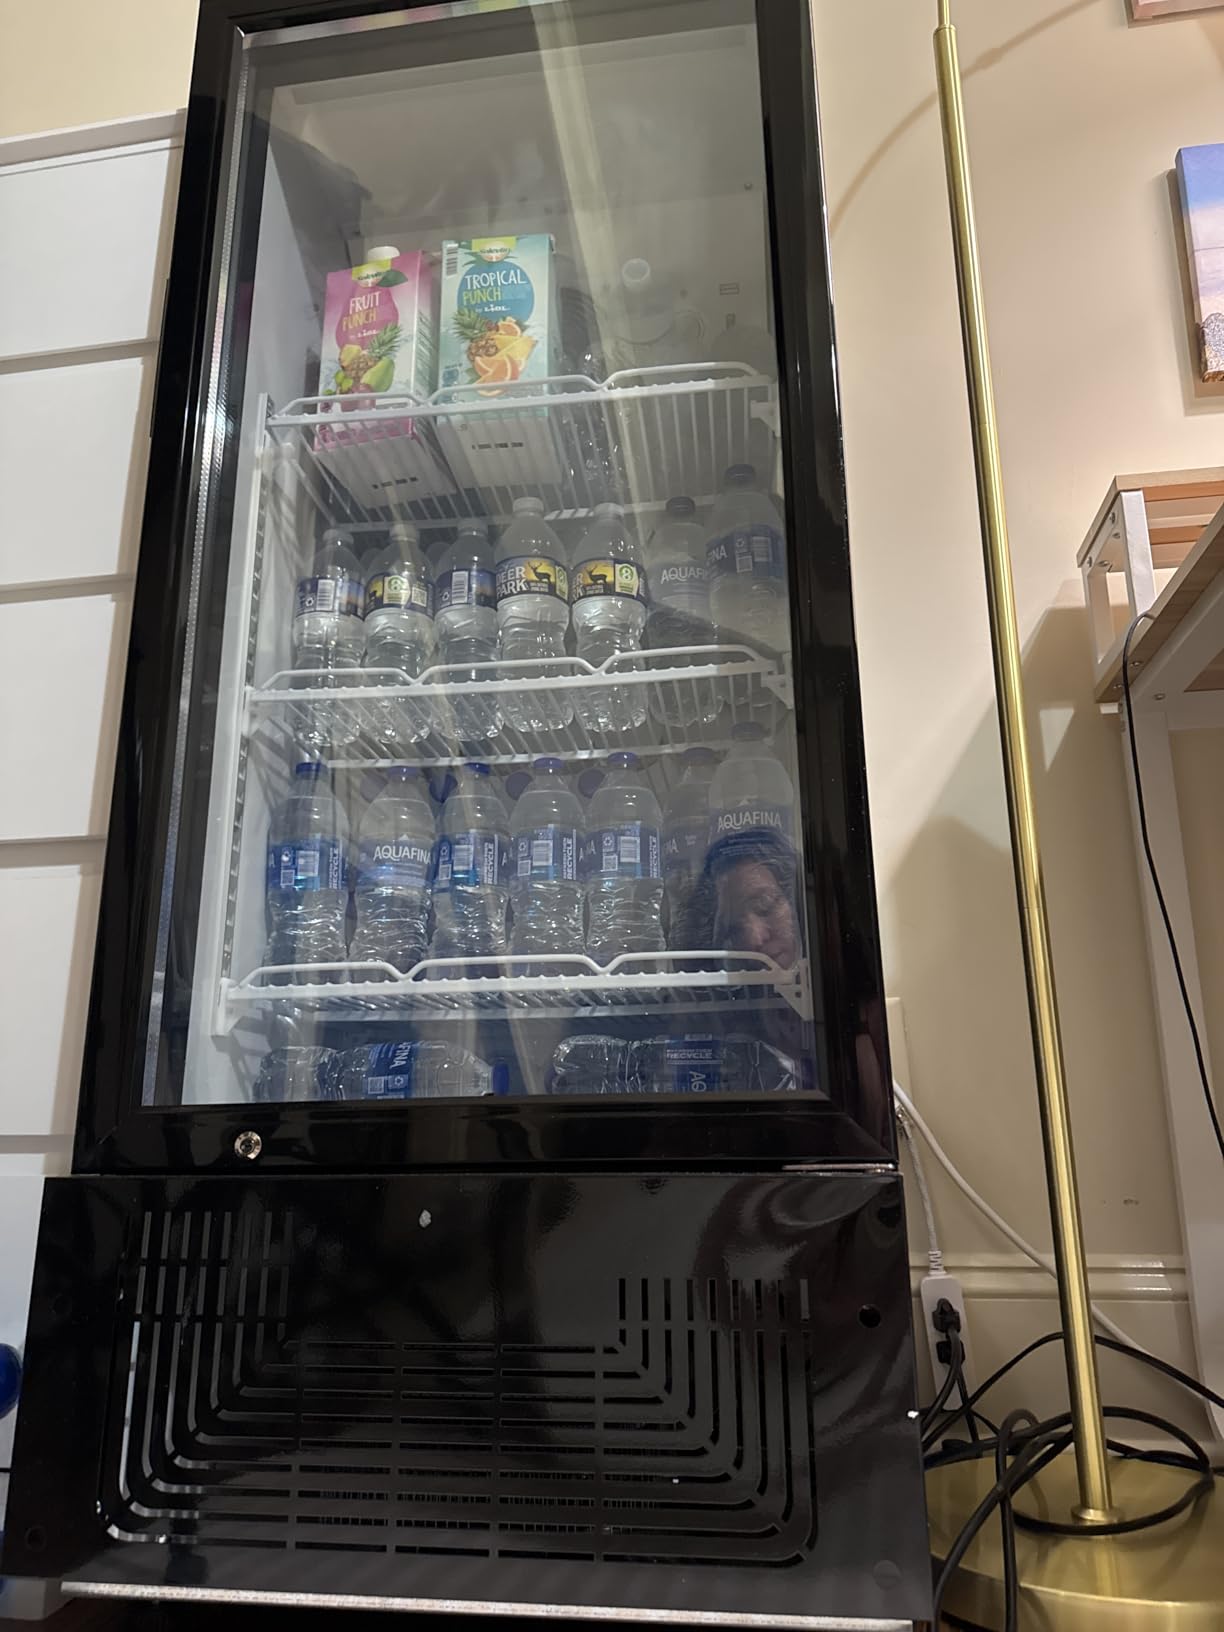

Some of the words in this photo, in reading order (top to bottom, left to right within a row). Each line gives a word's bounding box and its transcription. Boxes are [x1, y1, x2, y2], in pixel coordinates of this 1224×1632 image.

[464, 268, 528, 290] TROPICAL
[349, 291, 381, 315] FRUIT
[463, 287, 502, 306] PUNCH
[342, 308, 376, 332] PUNCH
[717, 811, 782, 832] AQUAFINA
[390, 1042, 411, 1070] FINA
